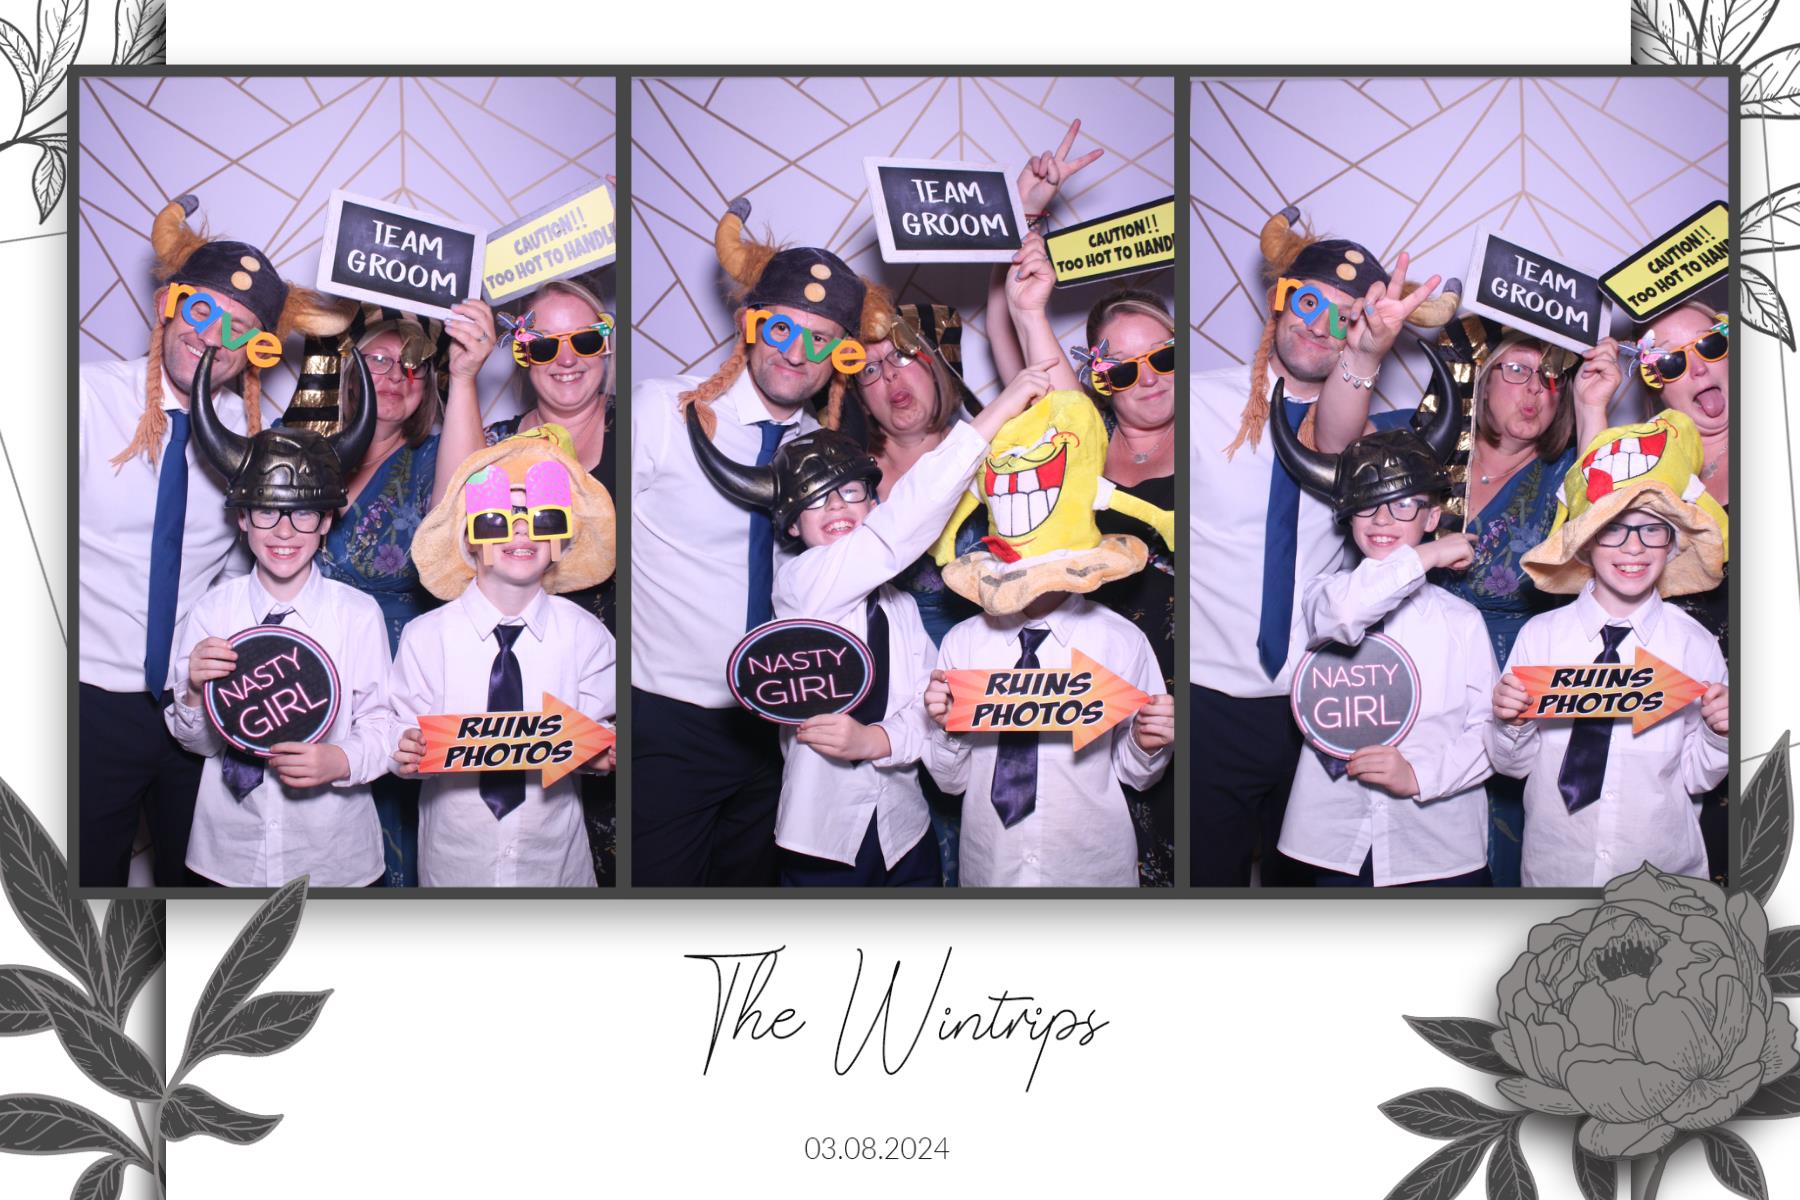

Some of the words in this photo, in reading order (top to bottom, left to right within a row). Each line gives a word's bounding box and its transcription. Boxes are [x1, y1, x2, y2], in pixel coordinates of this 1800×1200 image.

[911, 178, 985, 205] TEAM
[372, 219, 443, 260] TEAM
[513, 206, 587, 256] CAUTION!!
[901, 212, 1009, 238] GROOM
[1088, 213, 1160, 248] CAUTION!!
[485, 269, 514, 289] TOO
[514, 255, 544, 278] HOT
[543, 247, 563, 268] TO
[1056, 257, 1084, 273] TOO
[1086, 249, 1112, 268] HOT
[1112, 245, 1133, 261] TO
[1134, 233, 1175, 258] HAND
[1648, 225, 1716, 274] CAUTION!!
[346, 249, 458, 297] GROOM
[1514, 254, 1577, 299] TEAM
[1627, 287, 1657, 307] TOO
[1654, 270, 1684, 293] HOT
[1680, 260, 1702, 277] TO
[1697, 239, 1728, 268] HAN
[164, 282, 283, 368] rave
[1274, 277, 1347, 340] rav
[1491, 277, 1589, 333] GROOM
[745, 308, 867, 374] rave
[218, 646, 301, 708] NASTY
[748, 647, 847, 675] NASTY
[1312, 663, 1399, 689] NASTY
[1550, 667, 1654, 689] RUINS
[756, 673, 854, 705] GIRL
[985, 671, 1093, 697] RUINS
[1536, 691, 1664, 714] PHOTOS
[239, 682, 328, 738] GIRL
[457, 714, 562, 739] RUINS
[971, 700, 1104, 728] PHOTOS
[1314, 694, 1401, 728] GIRL
[443, 740, 573, 769] PHOTOS
